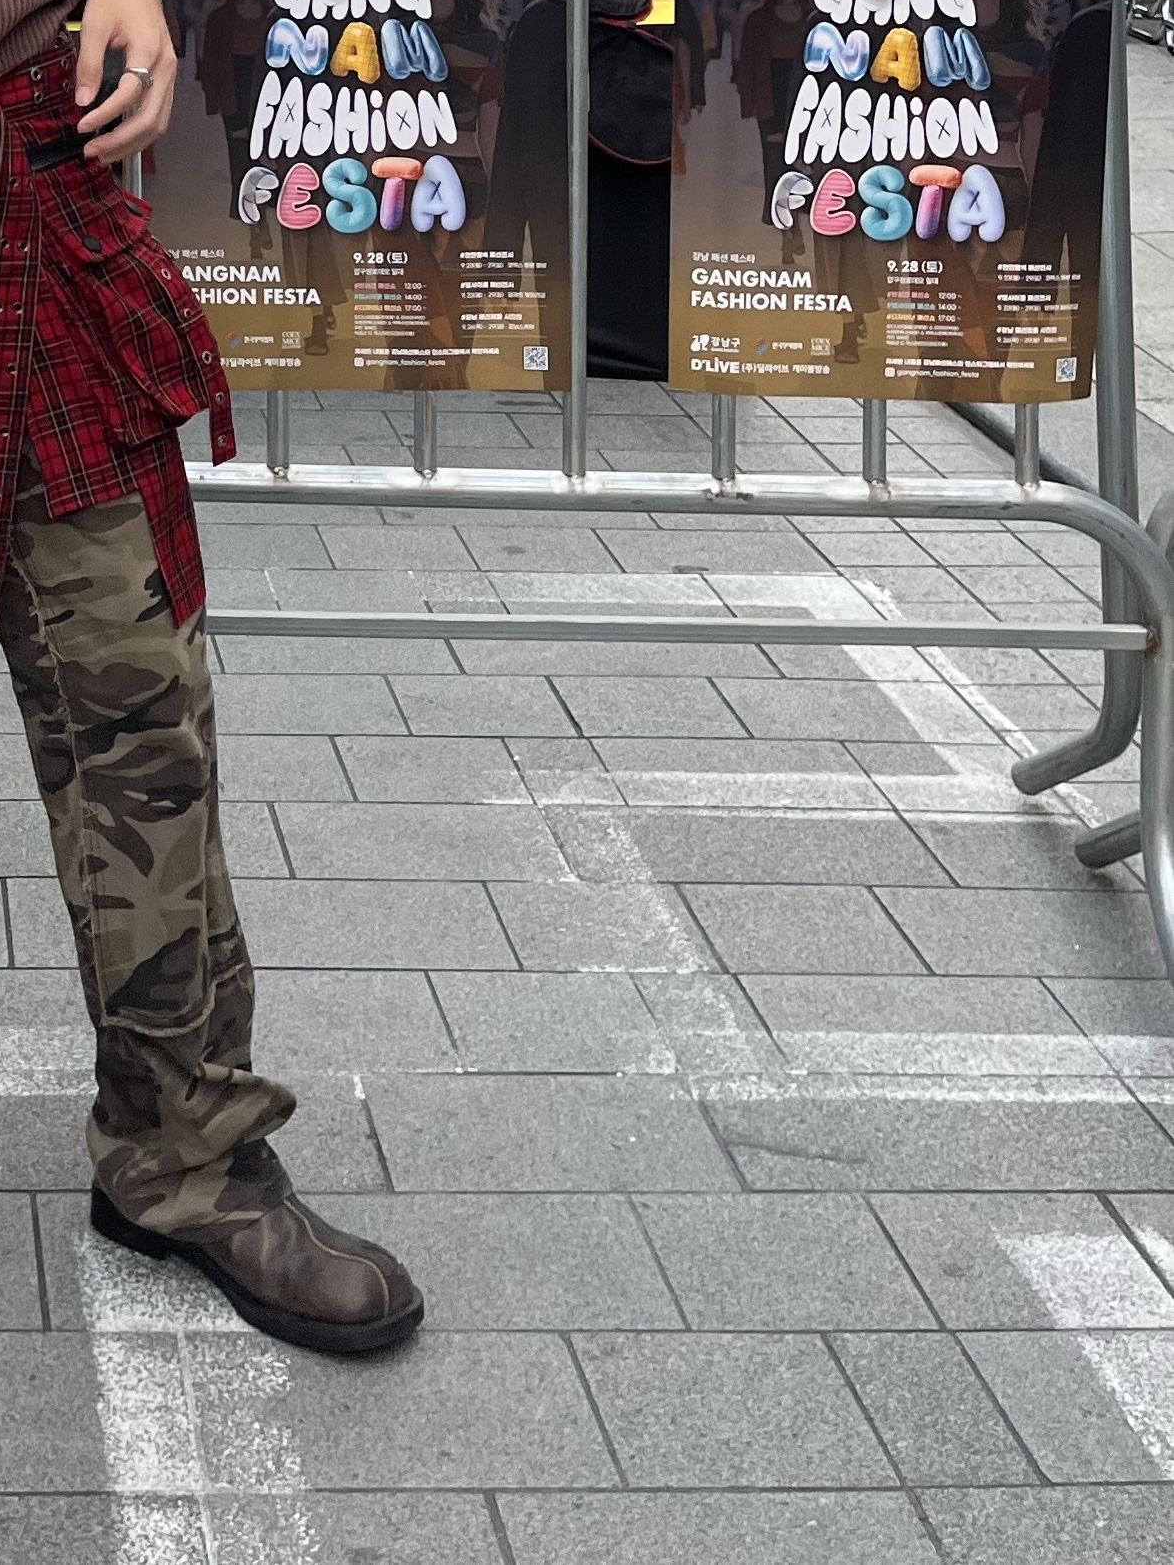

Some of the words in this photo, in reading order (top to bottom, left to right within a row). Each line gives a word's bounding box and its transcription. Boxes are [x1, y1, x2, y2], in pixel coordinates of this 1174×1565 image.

[264, 17, 449, 85] NAM
[803, 21, 991, 92] NAM
[237, 154, 467, 233] FESTA
[770, 163, 1006, 243] FESTA
[367, 252, 384, 264] 28
[386, 251, 408, 264] (토)
[692, 251, 709, 262] 강남
[711, 252, 729, 263] 패션
[730, 253, 756, 264] 페스타
[901, 260, 919, 273] 28
[921, 260, 943, 274] (토)
[182, 265, 281, 283] ANGNAM
[691, 267, 812, 289] GANGNAM
[191, 287, 257, 305] SHION
[263, 287, 322, 305] FESTA
[691, 290, 787, 311] FASHION
[793, 293, 853, 312] FESTA
[711, 336, 741, 348] 강남구
